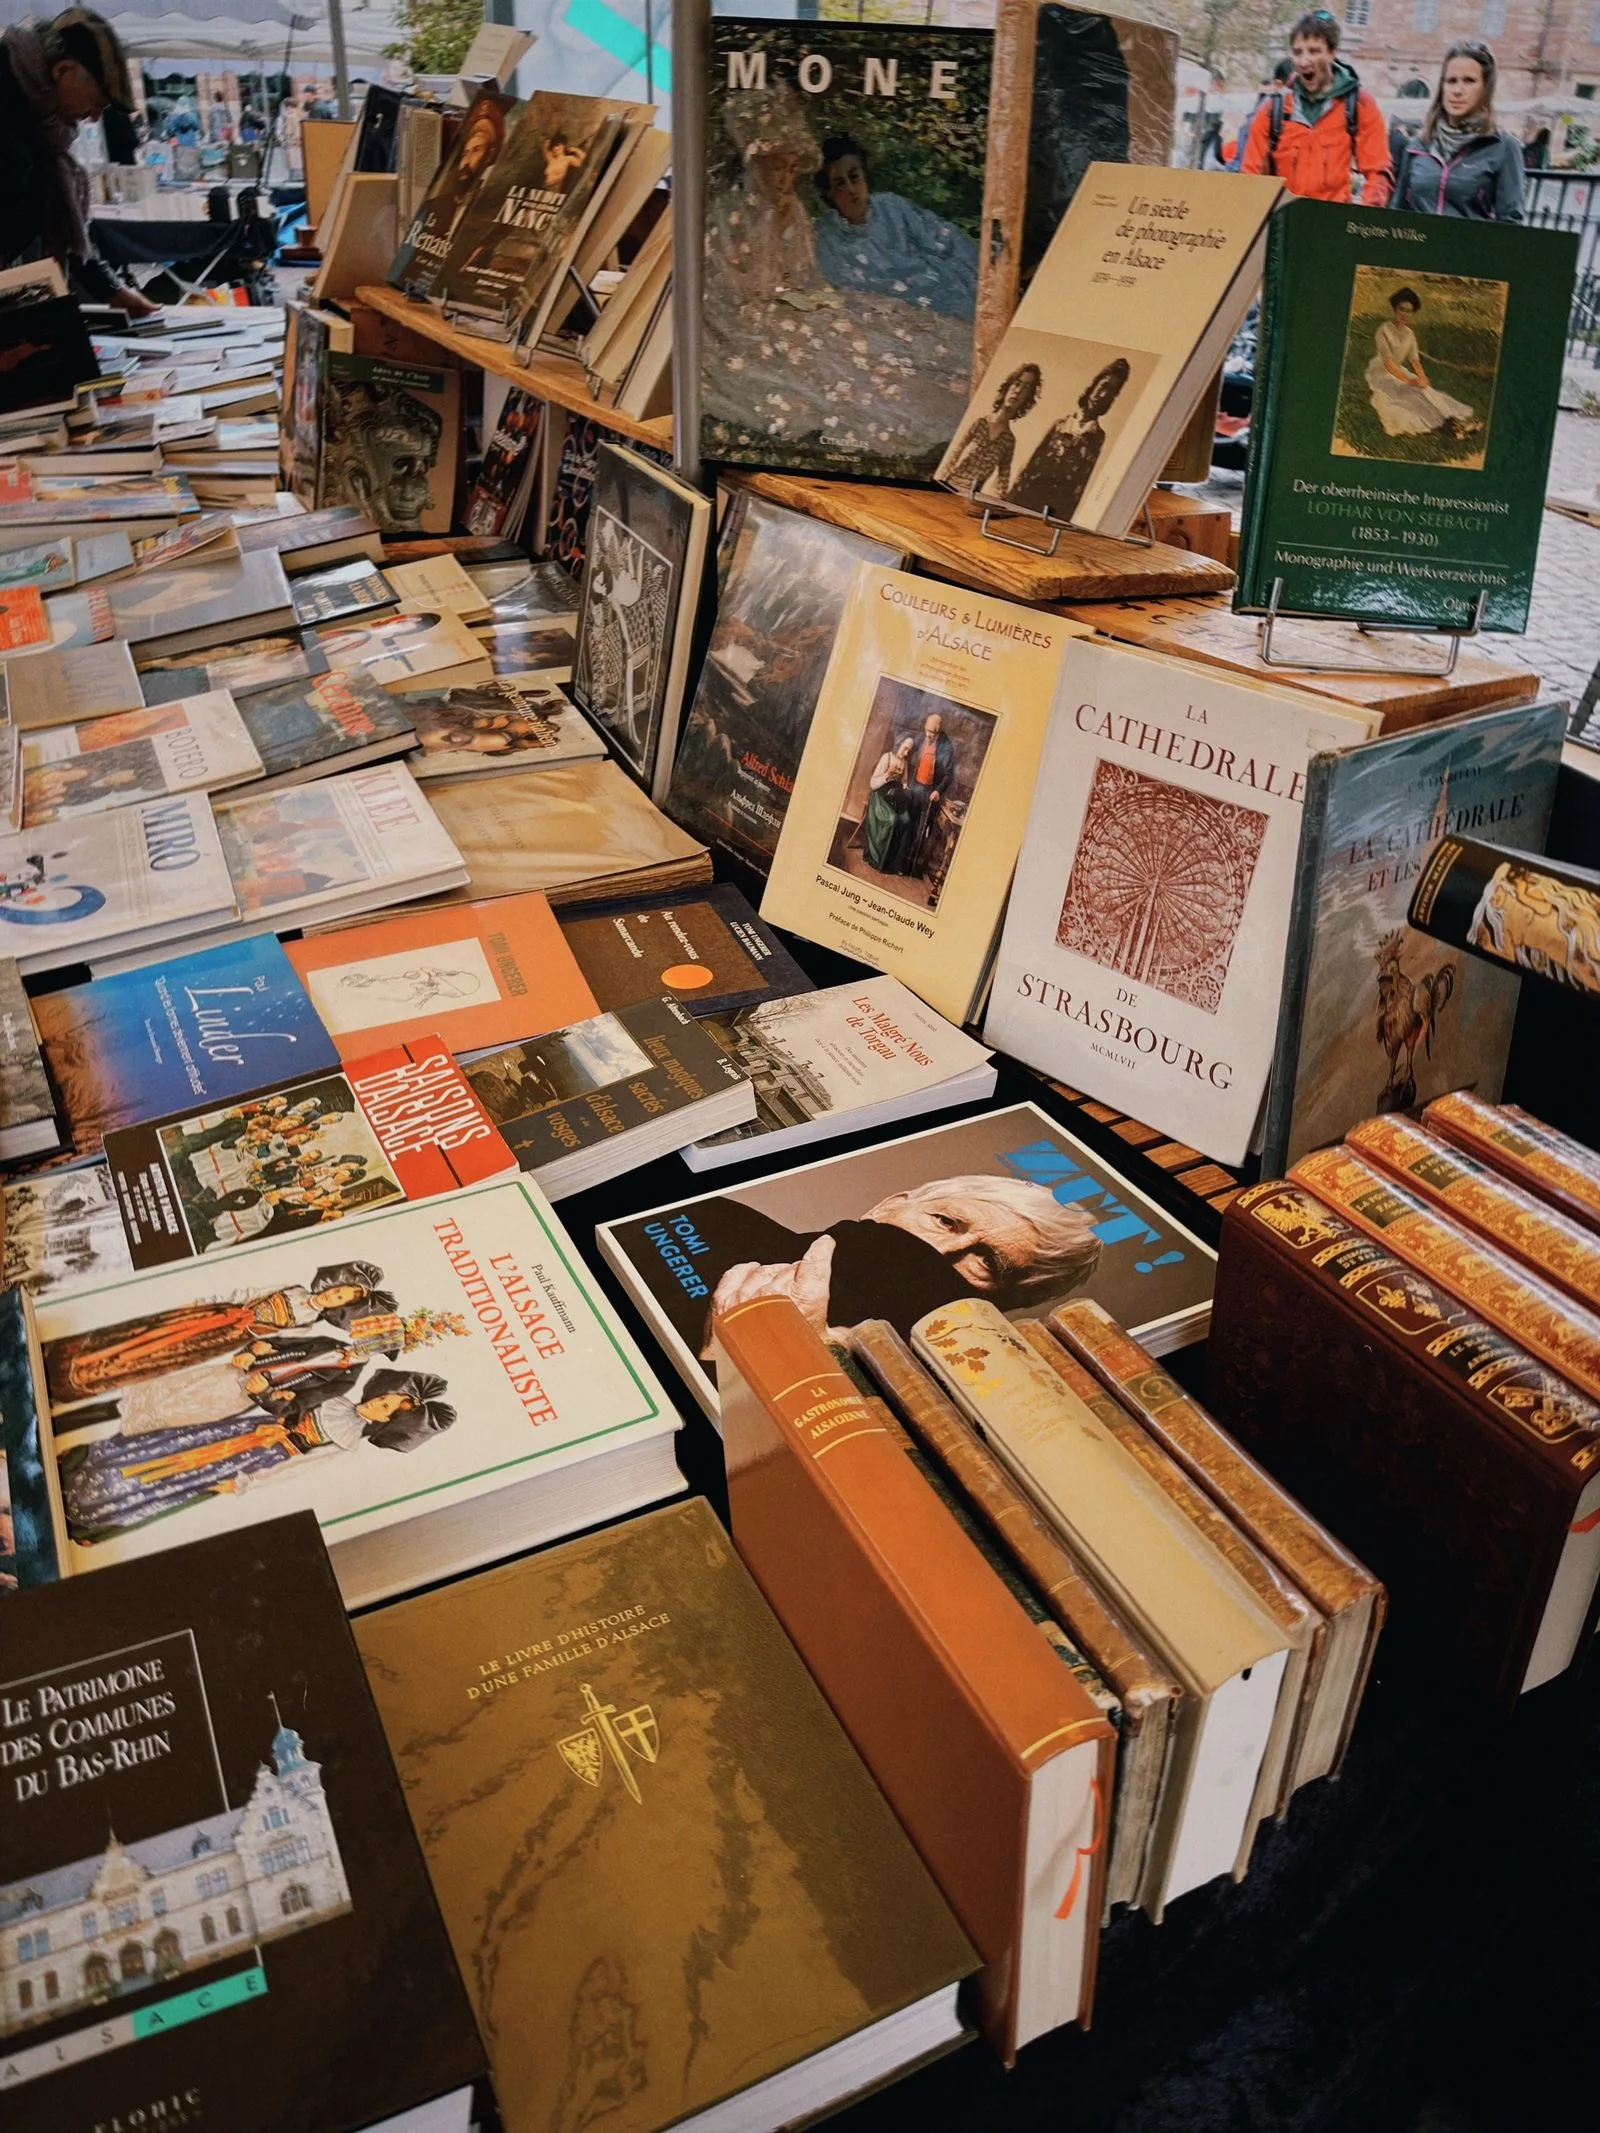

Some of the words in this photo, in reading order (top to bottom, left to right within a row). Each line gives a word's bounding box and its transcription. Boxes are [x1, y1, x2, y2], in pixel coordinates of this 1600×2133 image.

[1128, 195, 1149, 216] Un
[1115, 218, 1135, 238] de
[1131, 221, 1227, 253] photographie
[1346, 221, 1389, 239] Brigitte
[1102, 250, 1120, 265] en
[1120, 248, 1166, 270] Alsace
[1292, 479, 1319, 494] Der
[1321, 481, 1420, 505] oberrheinische
[1423, 492, 1510, 515] Impressionist
[1307, 500, 1373, 521] LOTHAR
[1377, 508, 1414, 524] VON
[1418, 512, 1489, 533] SEEBACH
[1274, 549, 1364, 572] Monographie
[1366, 557, 1393, 575] und
[1393, 562, 1508, 587] Werkverzeichnis
[880, 583, 957, 621] COULEURS
[961, 612, 972, 625] &
[974, 610, 1053, 650] LUMIÈRES
[1186, 704, 1208, 725] LA
[165, 728, 209, 780] BOTERO
[741, 751, 770, 778] Alfred
[1075, 703, 1308, 805] CATHEDRALE
[353, 770, 423, 834] KLEE
[1350, 837, 1375, 866] LA
[1368, 868, 1390, 892] ET
[637, 914, 650, 924] de
[816, 875, 841, 893] Pascal
[840, 887, 862, 905] Jung
[867, 900, 916, 928] Jean-Claude
[916, 921, 936, 940] Wey
[613, 918, 645, 959] Samarcande
[661, 911, 674, 922] Au
[668, 919, 700, 961] rendez-vous
[850, 923, 859, 932] de
[859, 926, 883, 944] Philippe
[882, 938, 904, 954] Richert
[496, 954, 529, 998] UNGERER
[1116, 987, 1139, 1008] DE
[184, 986, 298, 1066] Linder
[846, 1015, 864, 1029] de
[859, 1026, 898, 1061] Torgau
[852, 996, 875, 1014] Les
[868, 1011, 913, 1044] Malgré
[900, 1038, 934, 1068] Nous
[1017, 973, 1233, 1090] STRASBOURG
[643, 1033, 672, 1060] lieux
[661, 1055, 708, 1100] magiques
[1090, 1043, 1136, 1072] MCMLVII
[397, 1054, 492, 1151] SAISONS
[546, 1111, 583, 1149] vosges
[668, 1214, 711, 1256] TOMI
[643, 1221, 710, 1300] UNGERER
[489, 1252, 566, 1360] L'ALSACE
[531, 1263, 546, 1285] Paul
[542, 1281, 577, 1334] Kauffmann
[433, 1217, 559, 1428] TRADITIONALISTE
[793, 1395, 866, 1429] GASTRONOMIE
[810, 1387, 829, 1399] LA
[810, 1409, 871, 1440] ALSACIENNE
[479, 1660, 501, 1676] LE
[505, 1640, 554, 1666] LIVRE
[557, 1604, 647, 1647] D'HISTOIRE
[521, 1642, 594, 1679] FAMILLE
[596, 1612, 673, 1650] D'ALSACE
[1, 1697, 33, 1729] LE
[37, 1657, 167, 1718] PATRIMOINE
[0, 1732, 43, 1767] DES
[48, 1691, 178, 1751] COMMUNES
[14, 1768, 49, 1803] DU
[56, 1730, 173, 1790] BAS-RHIN
[3, 1975, 259, 2081] ALSACE
